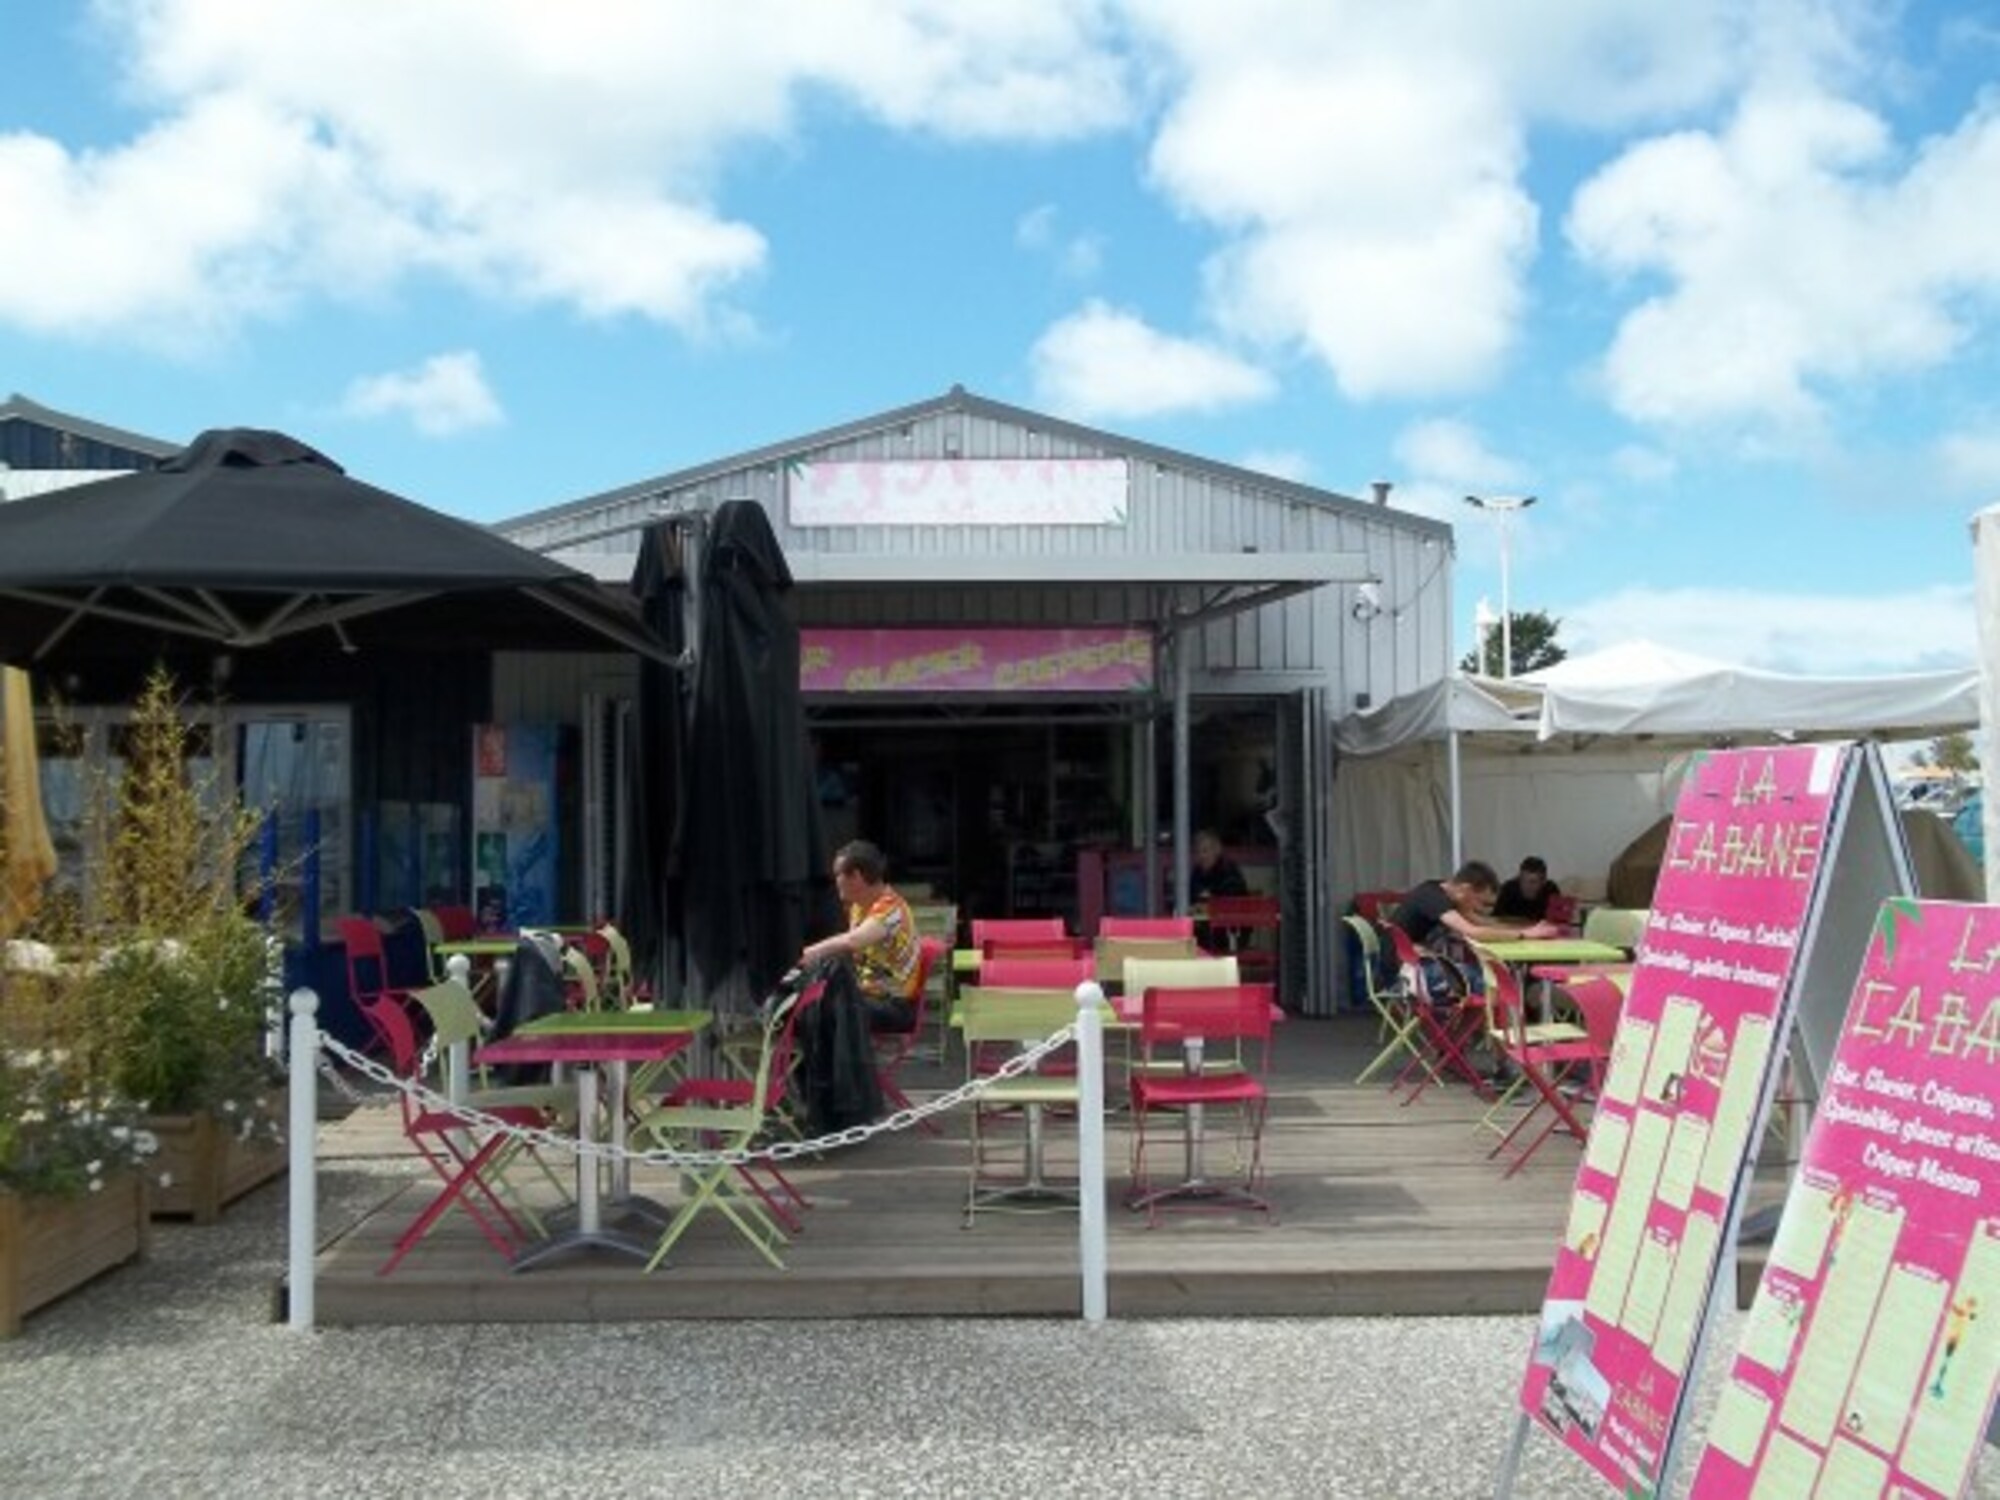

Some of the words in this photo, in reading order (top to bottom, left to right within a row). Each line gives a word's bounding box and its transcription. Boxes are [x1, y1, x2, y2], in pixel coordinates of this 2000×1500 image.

[1732, 755, 1778, 808] LA
[1669, 821, 1819, 879] CABANE
[1917, 1157, 1982, 1198] Maison
